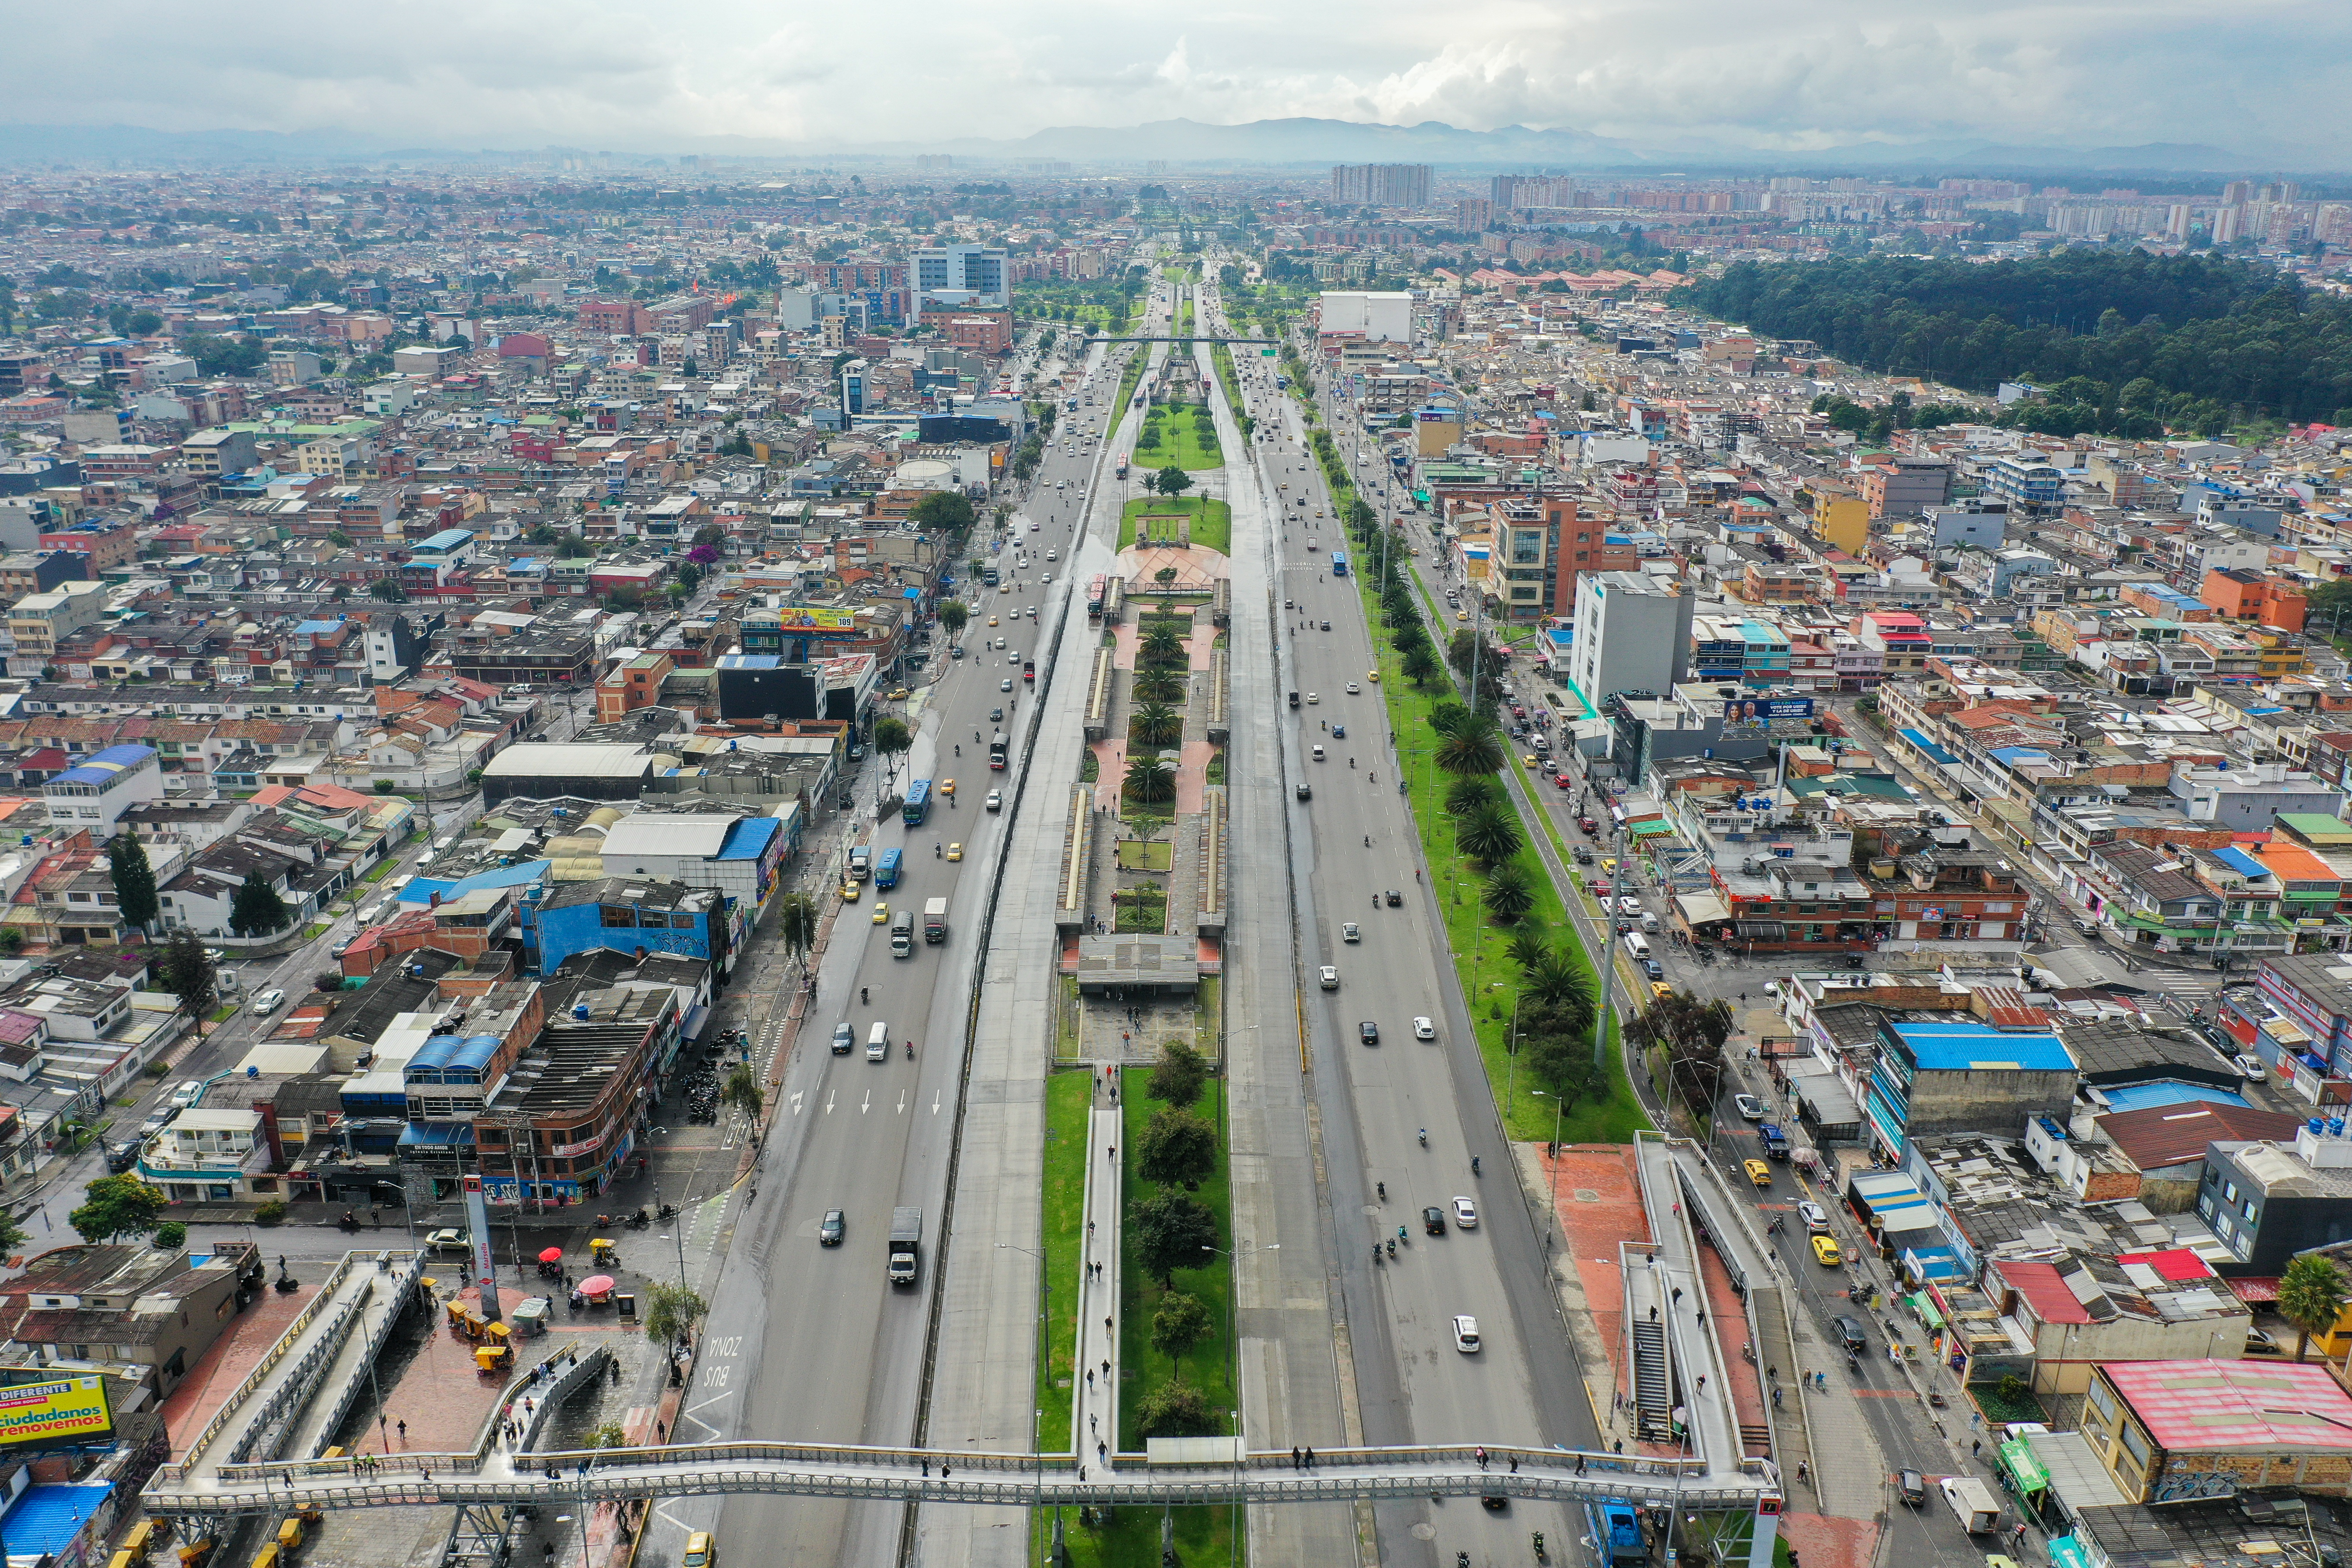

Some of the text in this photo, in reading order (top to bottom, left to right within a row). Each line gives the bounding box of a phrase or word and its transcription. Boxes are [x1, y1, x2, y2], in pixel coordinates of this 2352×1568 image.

[481, 1243, 490, 1269] Marsella
[709, 1336, 742, 1357] ZONA
[703, 1365, 730, 1387] BUS
[0, 1384, 68, 1400] DIFERENTE
[0, 1415, 104, 1437] renovemos
